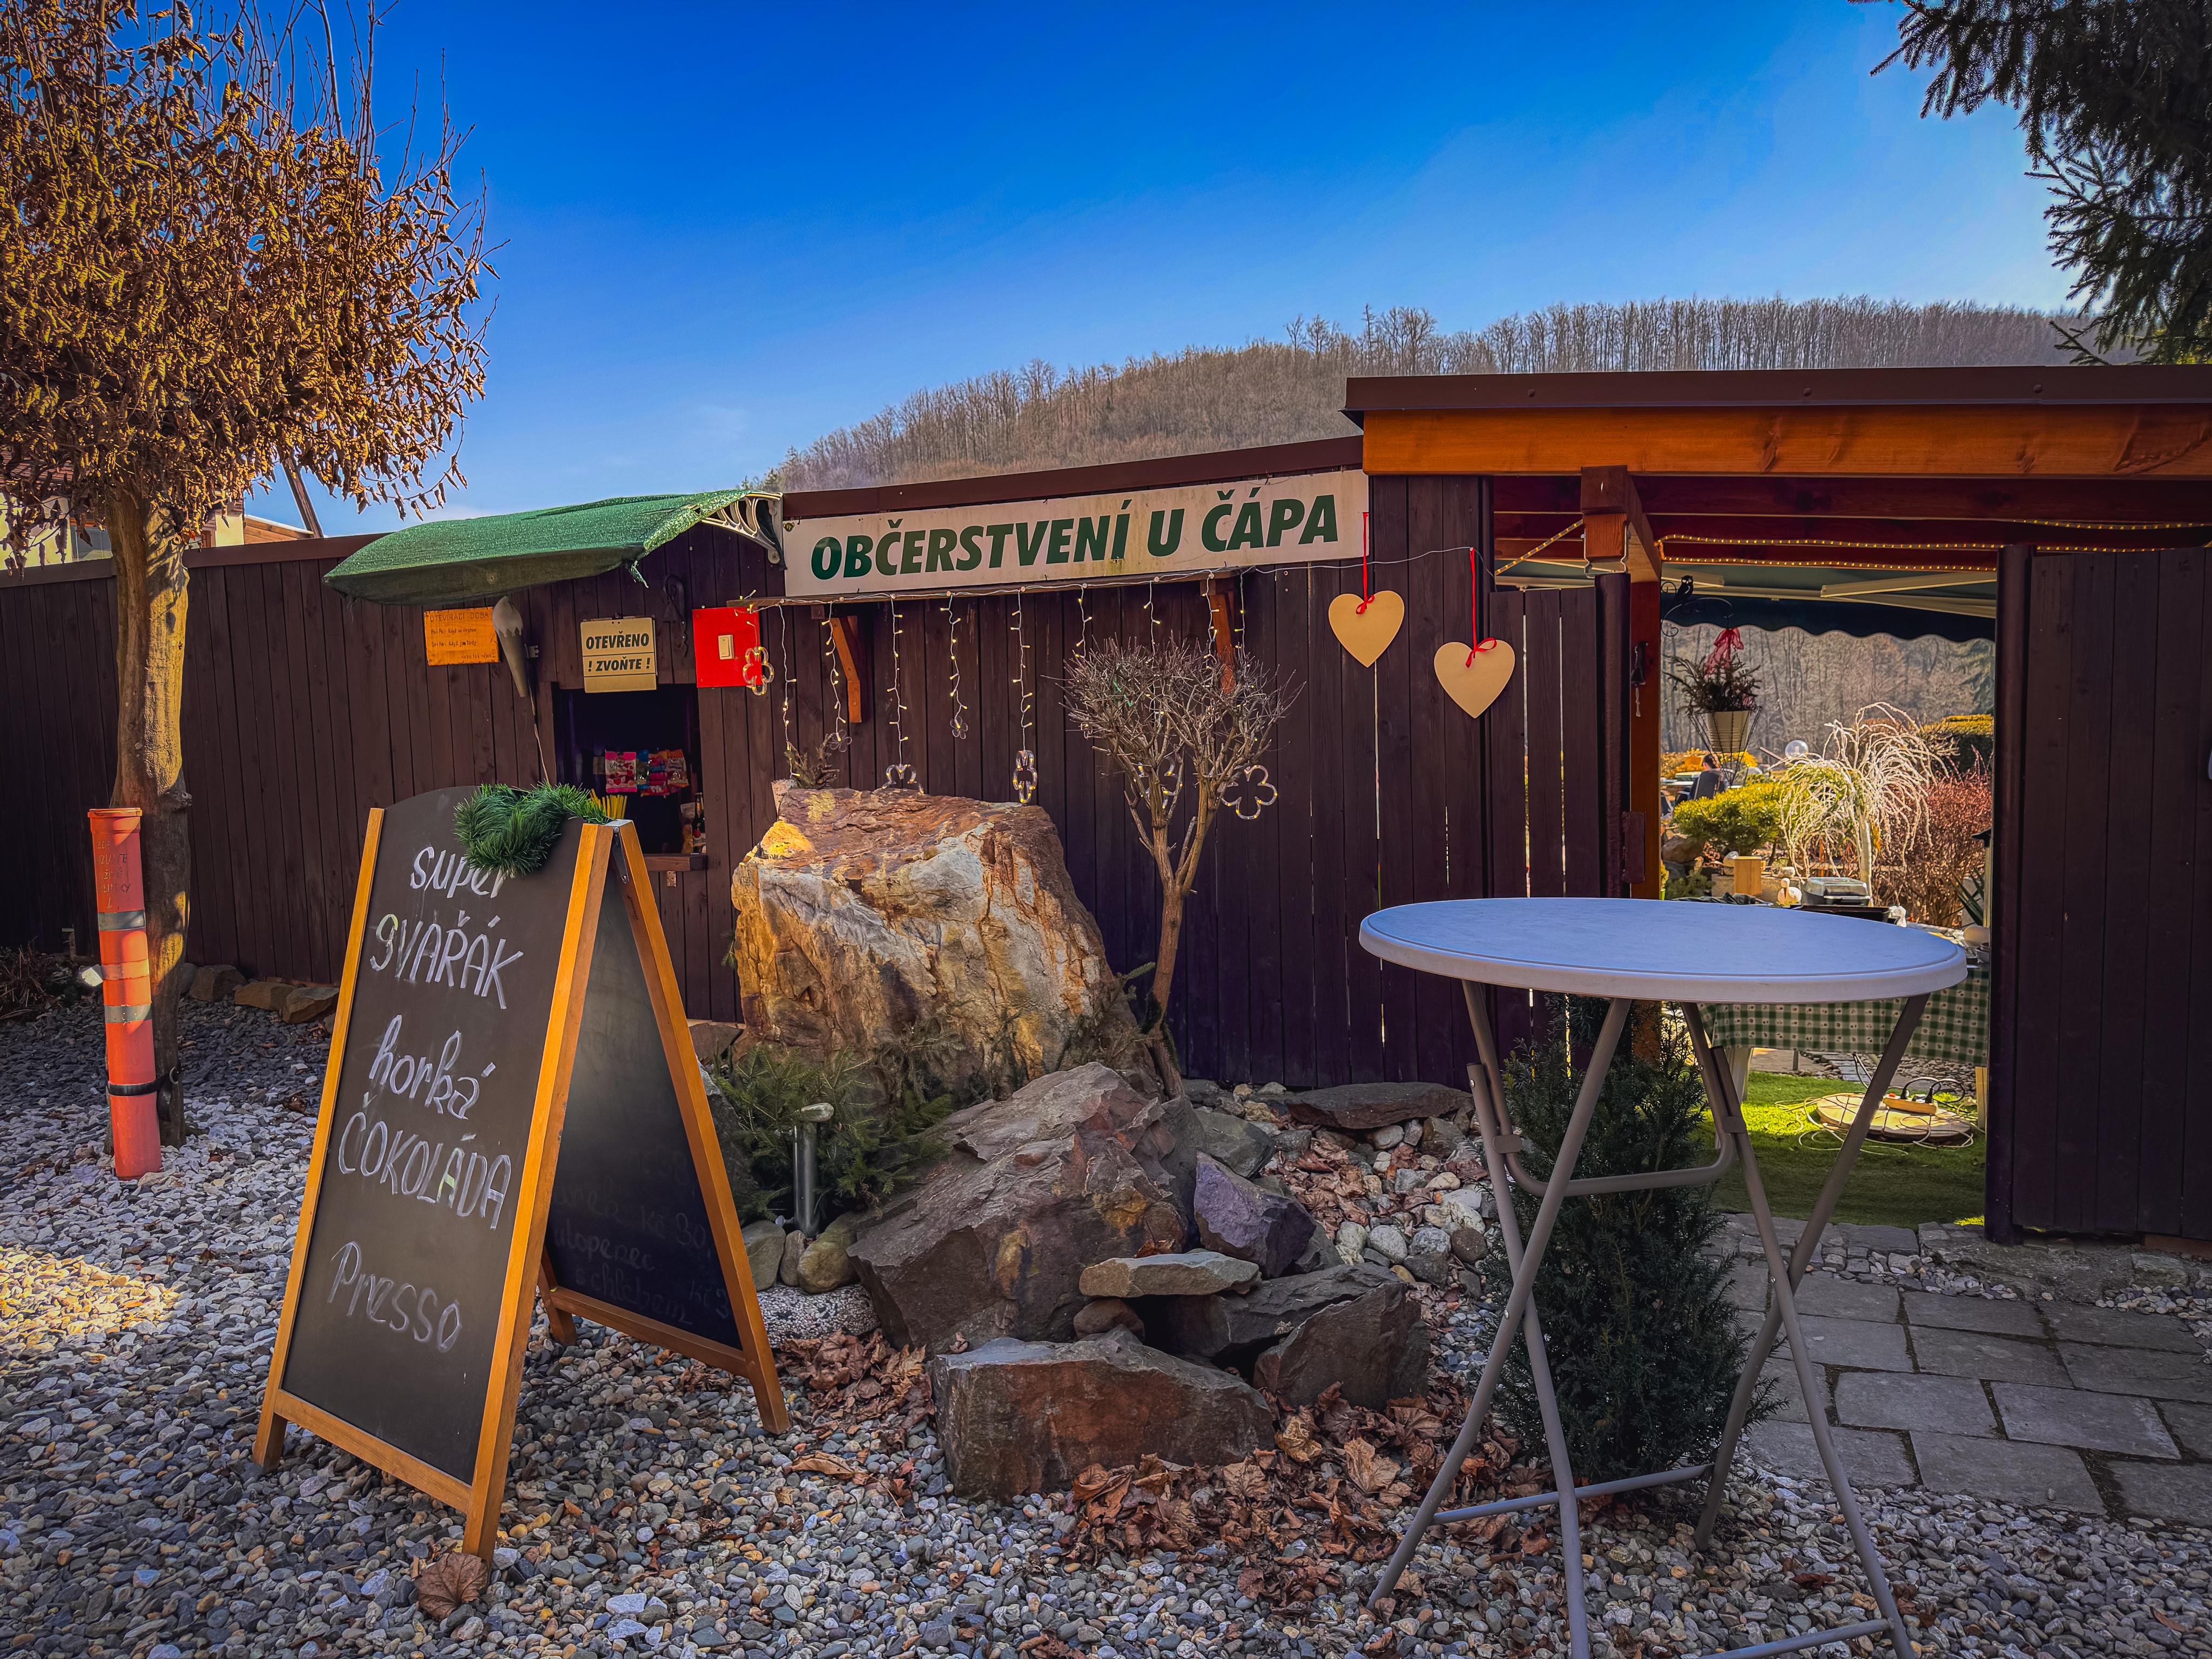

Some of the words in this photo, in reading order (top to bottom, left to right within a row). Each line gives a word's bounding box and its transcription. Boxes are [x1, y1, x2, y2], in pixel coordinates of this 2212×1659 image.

[811, 499, 1132, 581] OBČERSTVENÍ
[1147, 508, 1185, 557] U
[1201, 487, 1339, 553] ČÁPA
[586, 631, 650, 650] OTEVŘENO
[596, 656, 642, 671] ZVOŇTE
[369, 910, 523, 1009] SVAŘÁK
[369, 1014, 496, 1120] horká
[339, 1091, 511, 1230] ČOKOLÁDA
